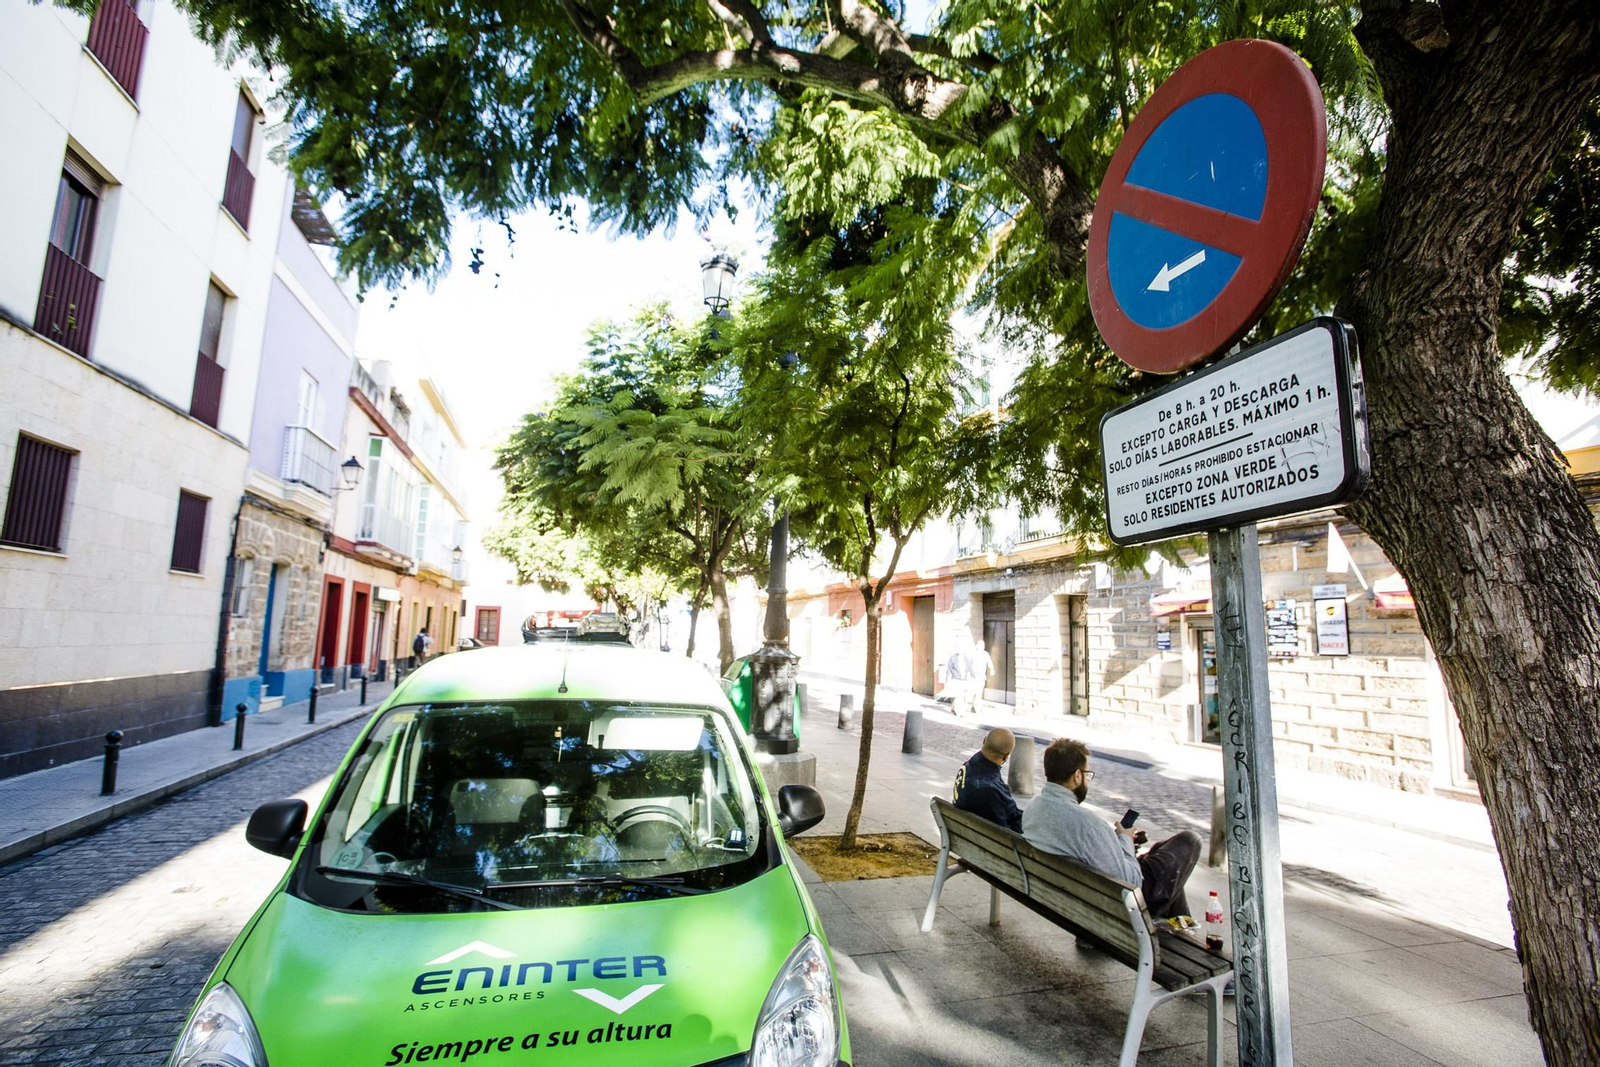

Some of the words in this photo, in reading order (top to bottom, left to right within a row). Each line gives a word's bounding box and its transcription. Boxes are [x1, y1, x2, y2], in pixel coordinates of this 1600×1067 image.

[1121, 427, 1165, 454] EXCEPTO
[1168, 410, 1208, 435] CARGA
[1211, 404, 1219, 419] Y
[1223, 373, 1301, 415] DESCARGA
[1158, 410, 1172, 423] De
[1175, 402, 1183, 416] 8
[1185, 399, 1196, 412] h.
[1199, 395, 1206, 406] a
[1209, 384, 1225, 402] 20
[1229, 380, 1241, 394] h.
[1109, 456, 1132, 475] SOLO
[1135, 446, 1158, 465] DÍAS
[1161, 417, 1239, 456] LABORABLES.
[1242, 393, 1300, 427] MÁXIMO
[1305, 388, 1312, 403] 1
[1316, 385, 1331, 400] h.
[1116, 481, 1140, 495] RESTO
[1141, 463, 1193, 489] DÍAS/HORAS
[1194, 447, 1243, 472] PROHIBIDO
[1246, 422, 1319, 456] ESTACIONAR
[1145, 480, 1193, 505] EXCEPTO
[1196, 469, 1230, 491] ZONA
[1233, 455, 1277, 479] VERDE
[1123, 510, 1148, 527] SOLO
[1150, 492, 1217, 521] RESIDENTES
[1221, 463, 1320, 503] AUTORIZADOS
[411, 955, 667, 995] ENINTER
[403, 990, 546, 1013] ASCENSORES
[384, 1033, 514, 1067] Siempre
[521, 1032, 540, 1050] a
[546, 1029, 580, 1049] su
[586, 1021, 673, 1045] altura
